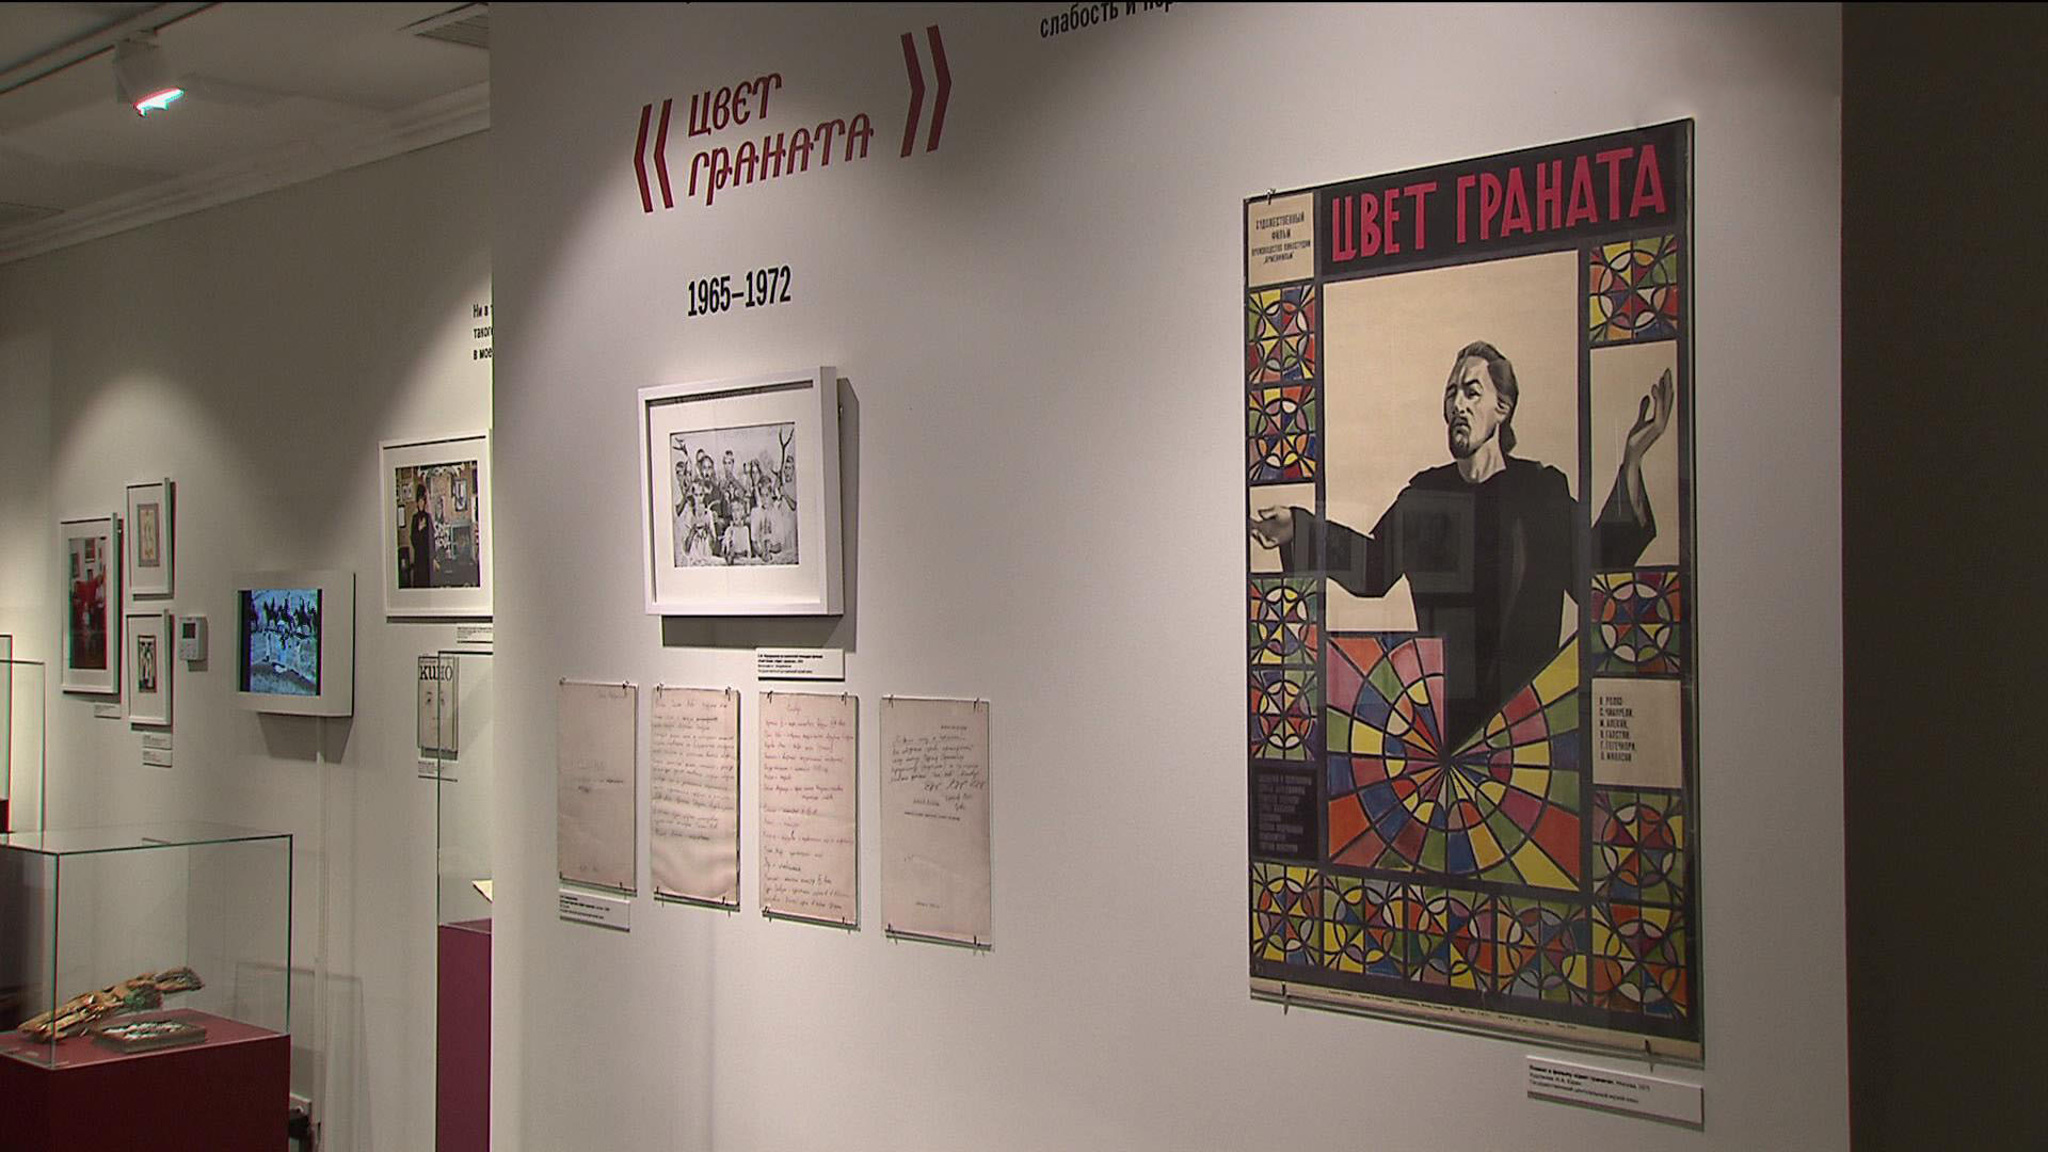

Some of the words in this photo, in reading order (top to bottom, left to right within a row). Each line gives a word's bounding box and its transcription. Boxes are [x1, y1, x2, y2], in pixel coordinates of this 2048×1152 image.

[1040, 2, 1119, 38] слабость
[1332, 182, 1437, 262] ЦВЕТ
[1456, 145, 1667, 244] ГРАНАТА
